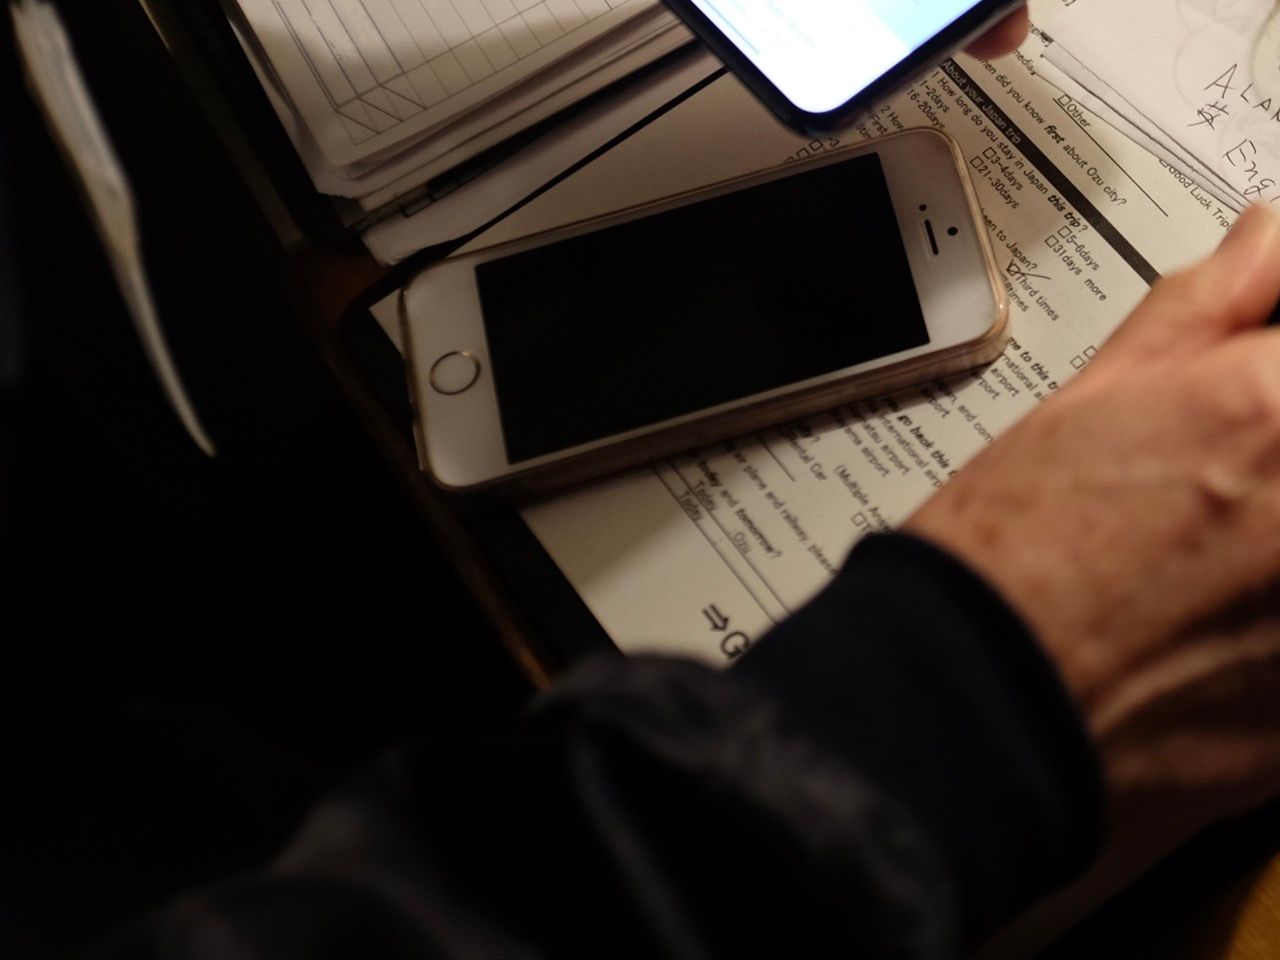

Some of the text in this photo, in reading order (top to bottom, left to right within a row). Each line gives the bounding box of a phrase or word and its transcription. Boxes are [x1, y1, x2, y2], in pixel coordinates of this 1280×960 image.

[940, 58, 1023, 146] About your Japan trip
[1065, 101, 1092, 130] Other
[936, 76, 957, 98] How
[952, 94, 974, 116] long
[969, 112, 984, 127] do
[978, 124, 998, 145] you
[994, 139, 1017, 163] stay
[1019, 166, 1050, 198] Japan
[1045, 191, 1068, 214] this
[1061, 208, 1089, 236] trip?
[994, 70, 1127, 210] did you know first about Ozu city?
[988, 153, 1026, 192] 3-4days
[1188, 185, 1214, 211] Luck
[975, 161, 1022, 210] 21-30days
[1050, 241, 1085, 277] 31days
[1081, 275, 1109, 304] more
[994, 227, 1038, 274] to Japan?
[1014, 270, 1064, 322] Third times
[989, 363, 1021, 399] airport
[1018, 348, 1050, 383] to this
[957, 401, 977, 423] and
[859, 443, 891, 479] airport
[879, 440, 912, 477] airport
[910, 423, 935, 451] back
[928, 446, 951, 471] this
[741, 461, 770, 493] plane
[763, 489, 783, 511] and
[808, 461, 829, 484] Car
[832, 463, 870, 508] (Multiple
[676, 488, 709, 524] Today
[691, 479, 722, 513] Today
[719, 487, 739, 509] and
[734, 505, 782, 562] tomorrow?
